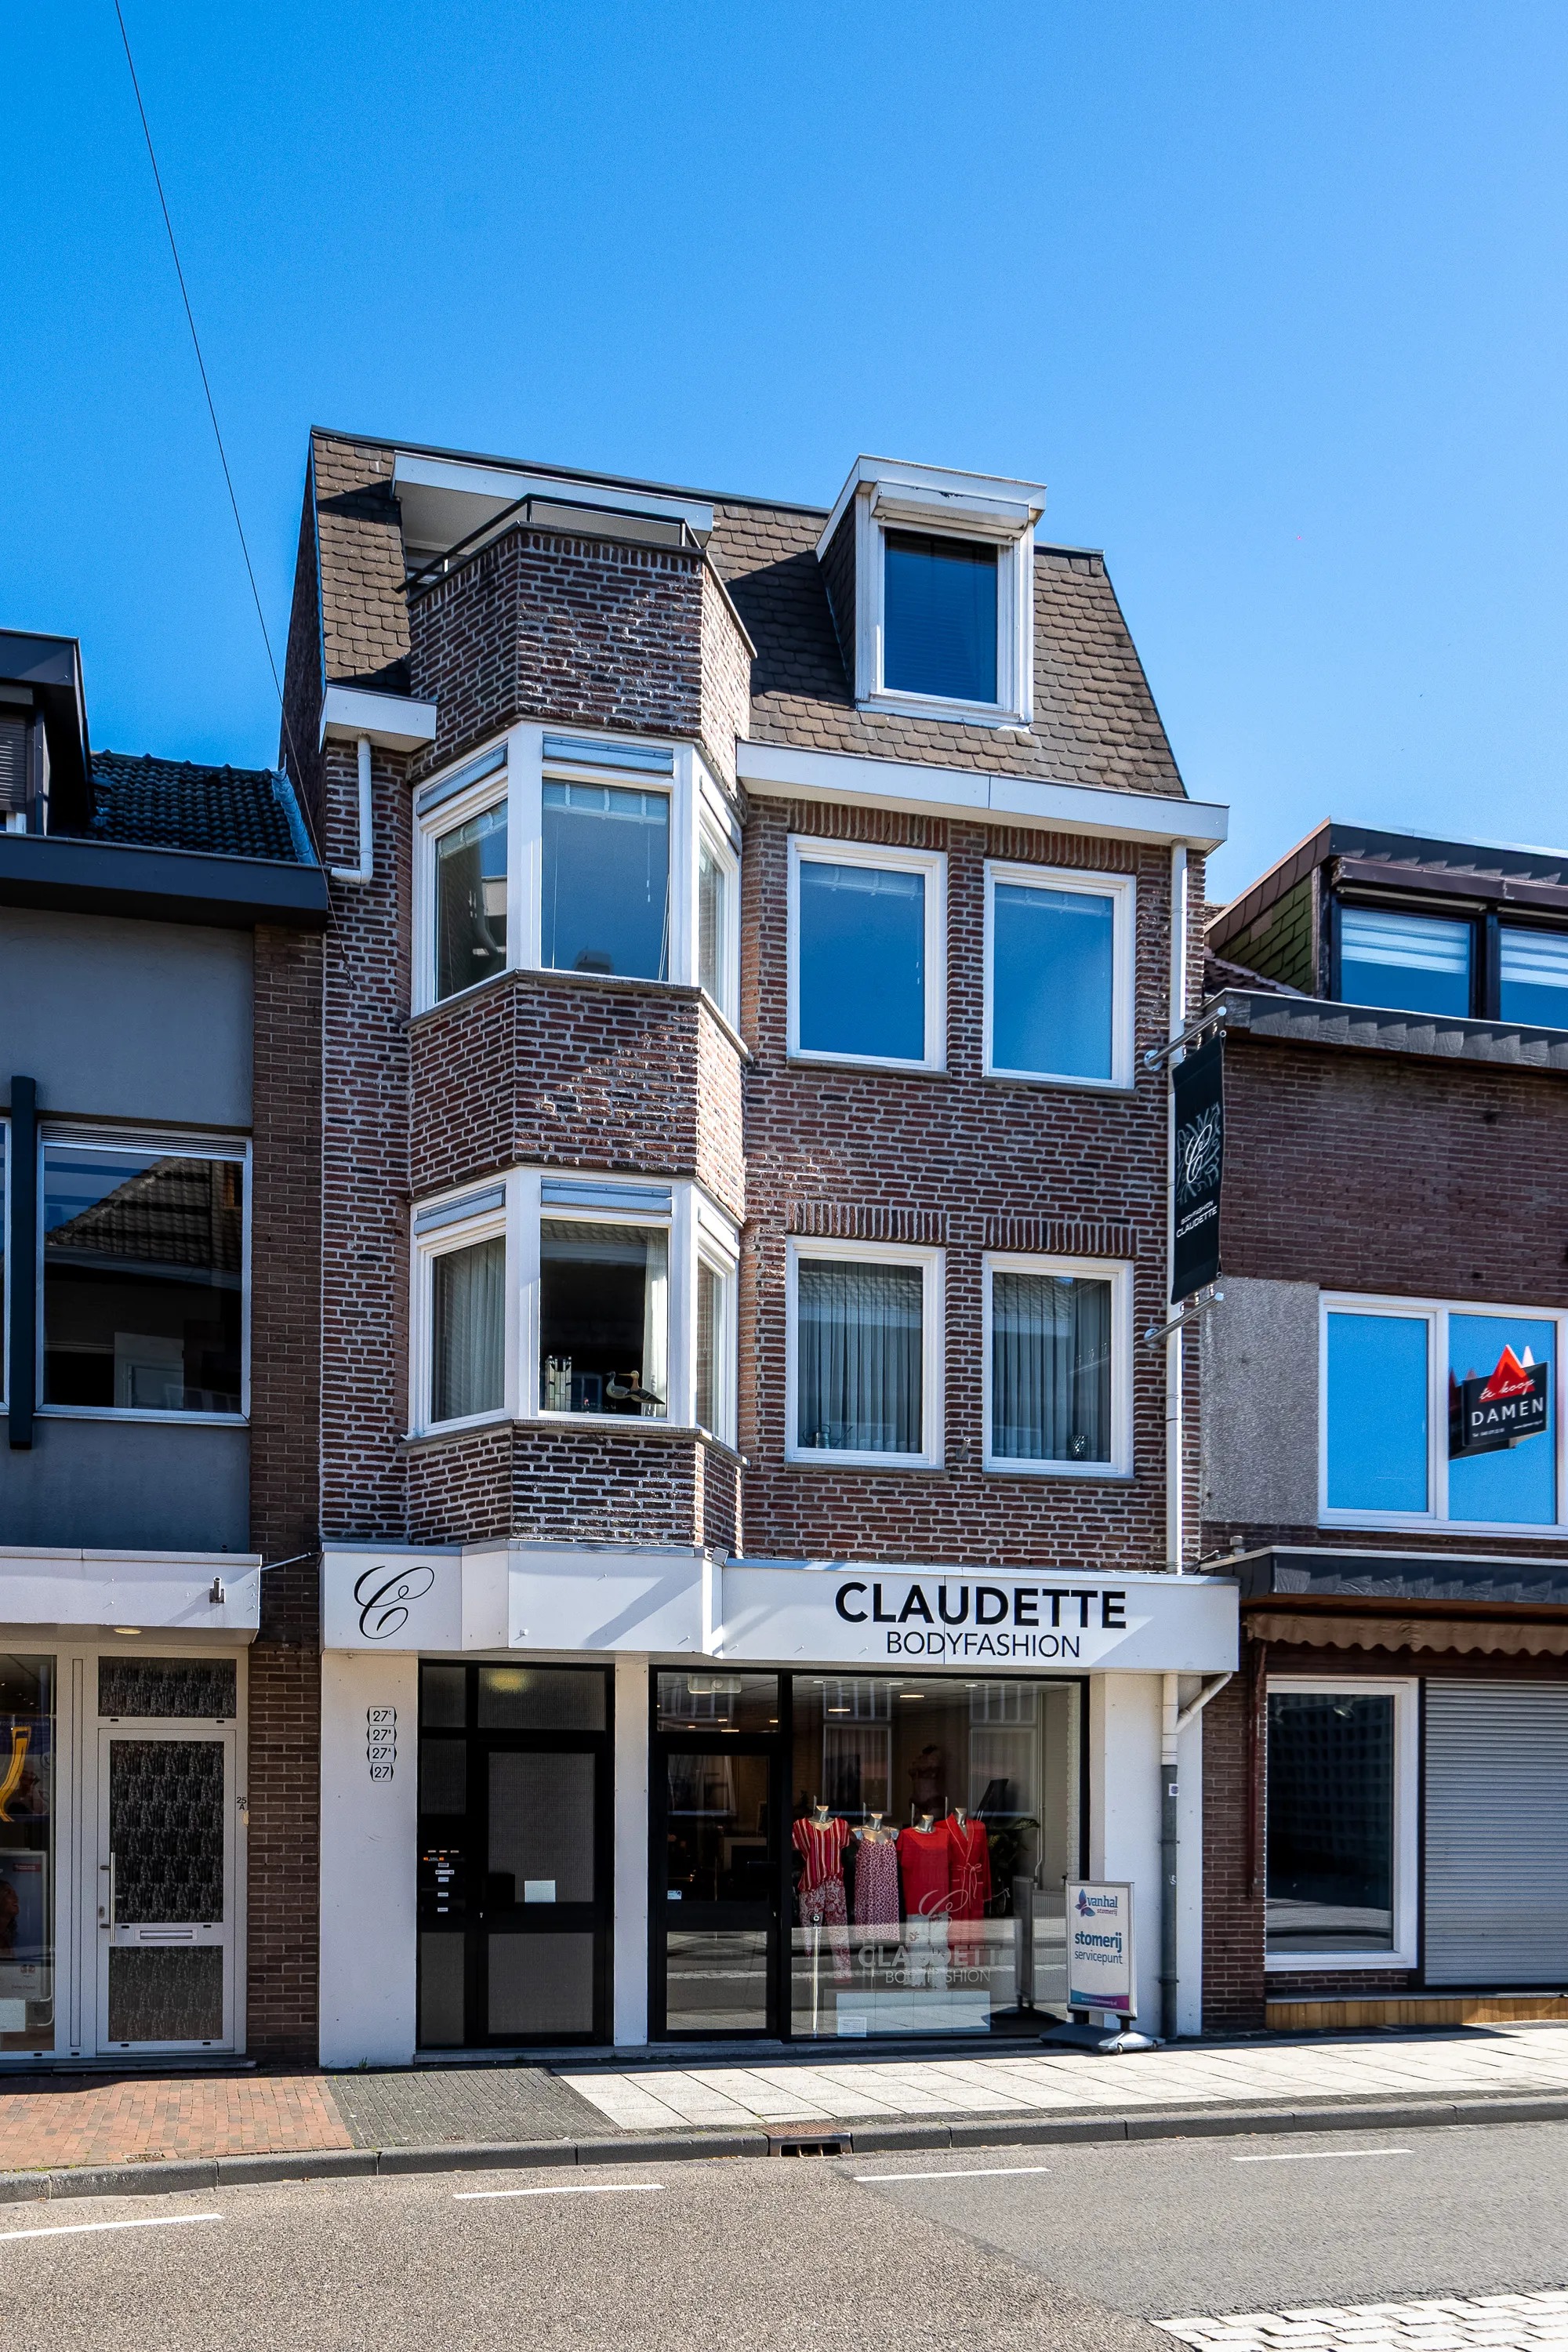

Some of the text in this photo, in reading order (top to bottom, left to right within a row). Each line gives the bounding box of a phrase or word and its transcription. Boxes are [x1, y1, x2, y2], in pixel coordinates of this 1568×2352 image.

[1176, 1205, 1218, 1238] CLAUDETTE
[1479, 1378, 1536, 1400] te koop
[1471, 1397, 1544, 1426] DAMEN
[835, 1582, 1127, 1628] CLAUDETTE
[887, 1631, 1080, 1658] BODYFASHION
[374, 1766, 390, 1778] 27
[1087, 1895, 1118, 1908] vanhal
[1074, 1930, 1122, 1953] stomerij
[1074, 1950, 1123, 1965] servicepunt
